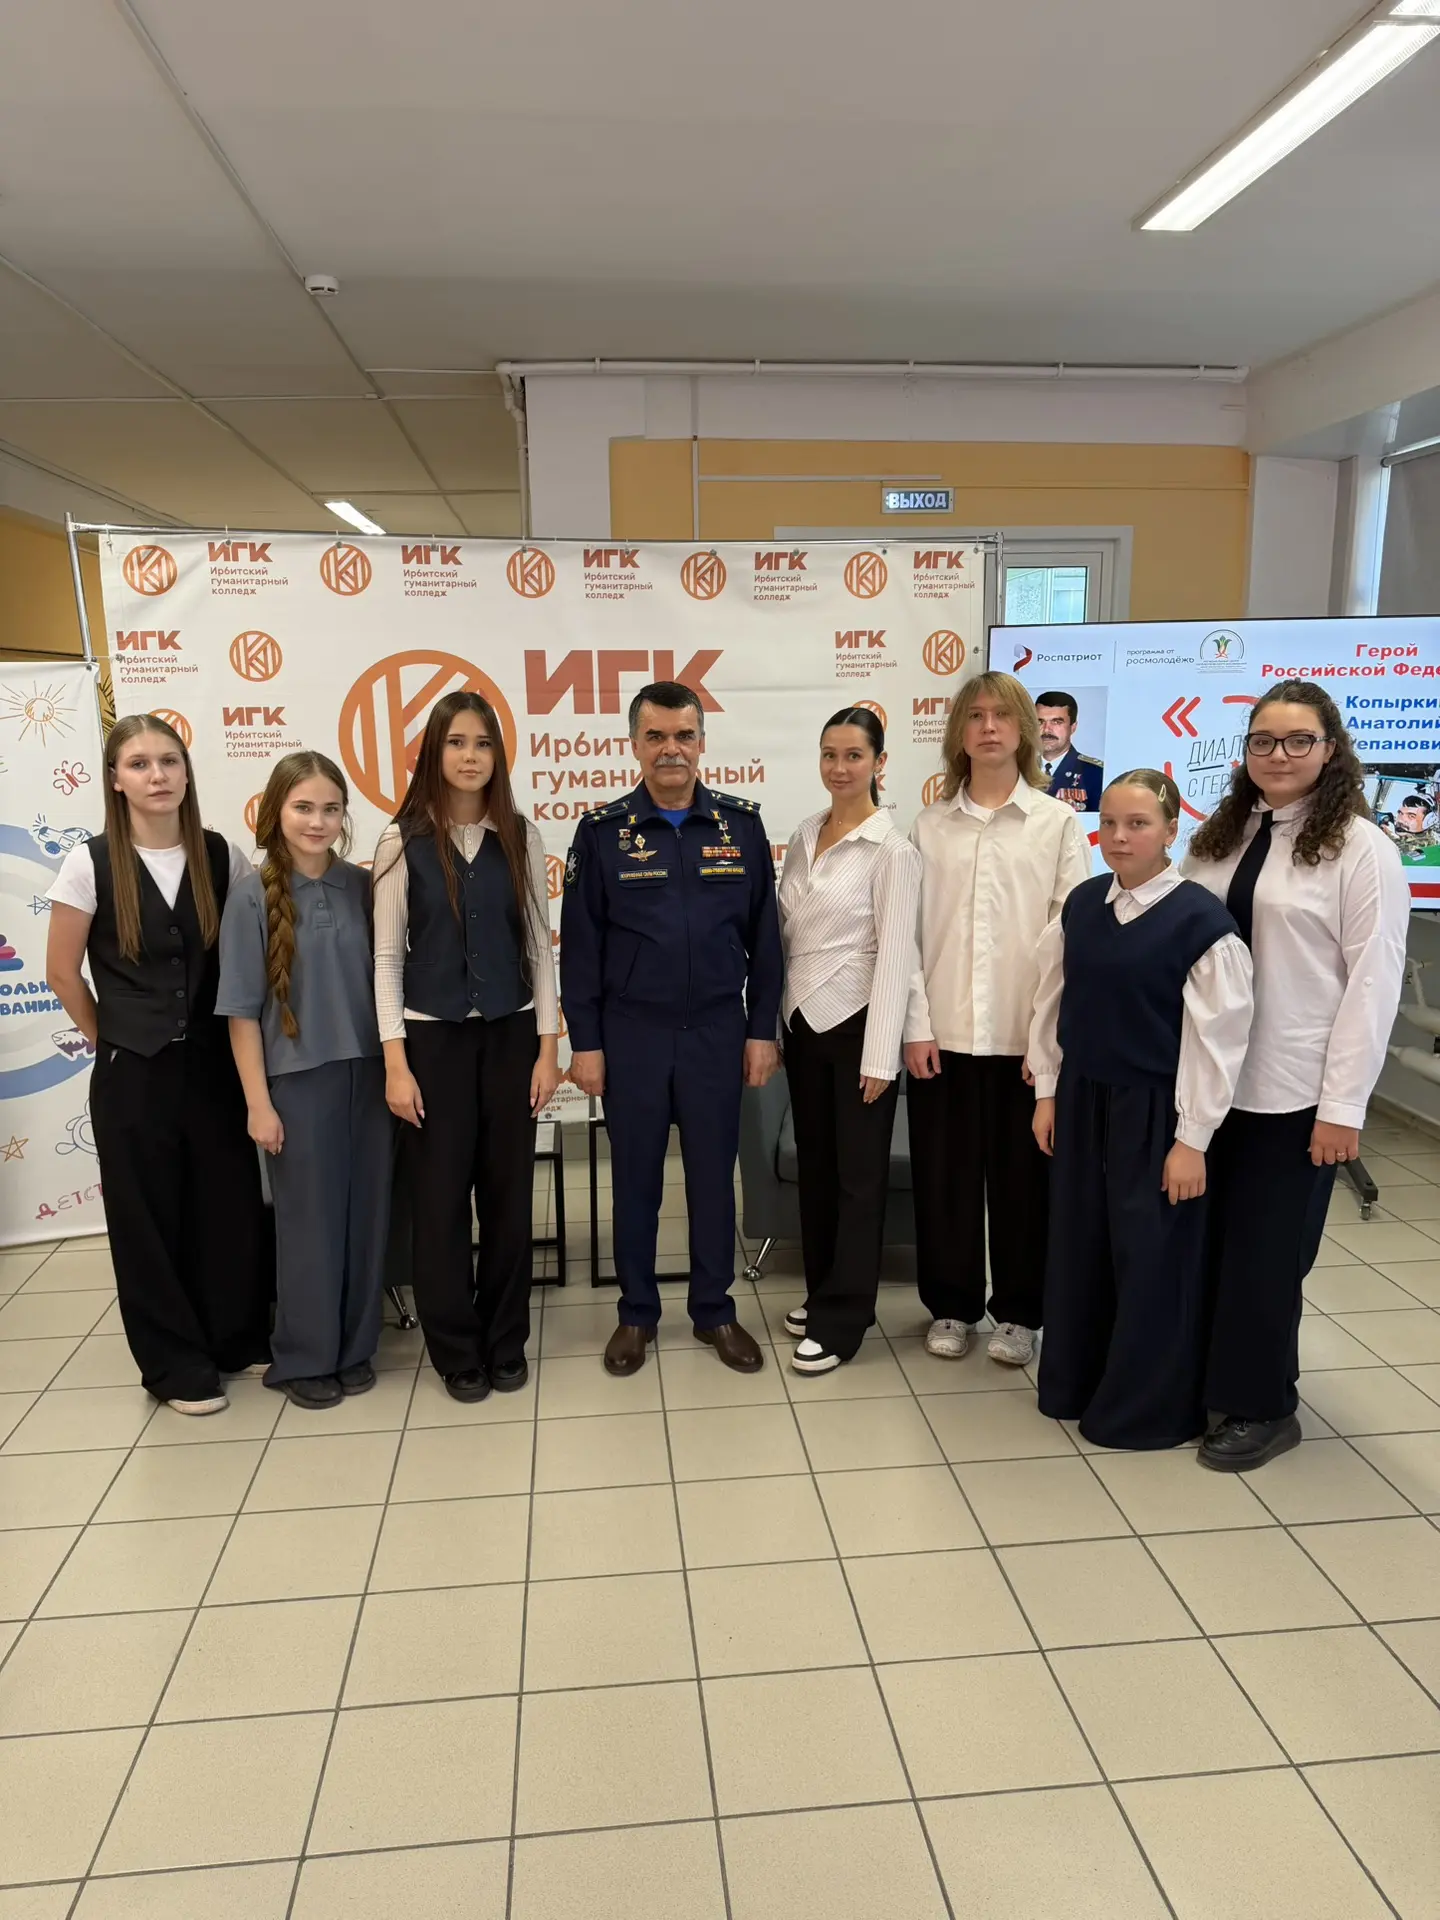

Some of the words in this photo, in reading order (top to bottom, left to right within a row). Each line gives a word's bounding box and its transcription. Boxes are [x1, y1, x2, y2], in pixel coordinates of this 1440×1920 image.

[888, 493, 947, 508] ВЫХОД
[208, 542, 273, 562] ИГК
[401, 545, 463, 565] ИГК
[584, 549, 640, 568] ИГК
[755, 552, 808, 570] ИГК
[914, 551, 964, 569] ИГК
[210, 567, 268, 576] Ирбитский
[403, 569, 458, 578] Ирбитский
[584, 572, 635, 581] Ирбитский
[211, 577, 288, 586] гуманитарный
[754, 574, 801, 583] Ирбитский
[914, 573, 959, 582] Ирбитский
[404, 580, 477, 589] гуманитарный
[585, 582, 653, 591] гуманитарный
[754, 583, 817, 592] гуманитарный
[914, 581, 975, 590] гуманитарный
[116, 631, 183, 650] ИГК
[835, 630, 886, 648] ИГК
[836, 652, 881, 661] Ирбитский
[1356, 643, 1418, 660] Герой
[119, 655, 177, 665] Ирбитский
[1037, 653, 1102, 663] Роспатриот
[1126, 656, 1195, 667] росмолодёжь
[120, 664, 198, 675] гуманитарный
[836, 660, 897, 670] гуманитарный
[1262, 663, 1386, 677] Российской
[121, 676, 167, 684] колледж
[524, 650, 725, 715] ИГК
[1346, 696, 1440, 711] Копырки
[222, 707, 287, 726] ИГК
[225, 730, 281, 740] Ирбитский
[913, 728, 946, 736] гуманит
[226, 740, 302, 750] гуманитарный
[1355, 740, 1440, 750] епанови
[227, 750, 272, 758] колледж
[1187, 735, 1242, 768] ДИАЛ
[532, 758, 765, 795] гуманиный
[1188, 778, 1198, 797] С
[1201, 773, 1231, 796] ГЕР
[0, 981, 52, 996] ОЛЬН
[36, 1183, 103, 1220] ДЕТСТ
